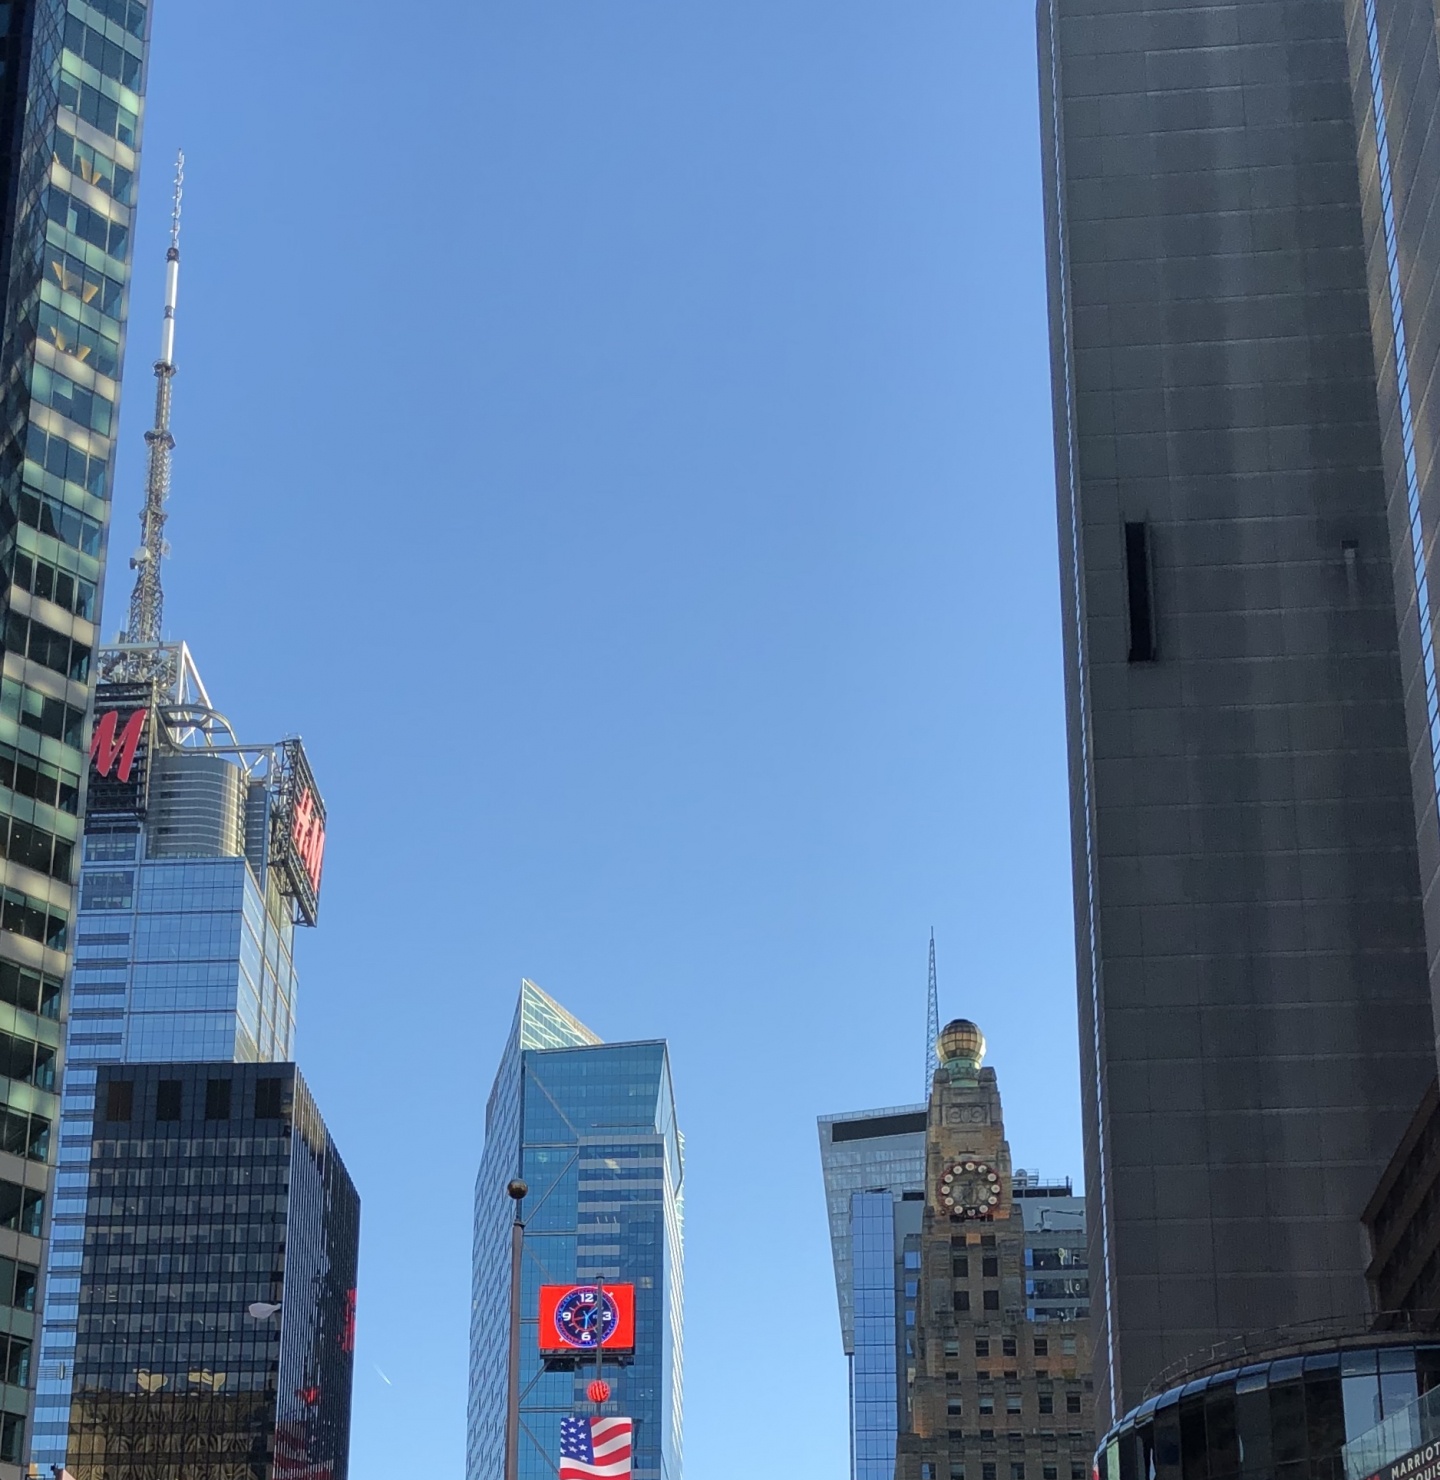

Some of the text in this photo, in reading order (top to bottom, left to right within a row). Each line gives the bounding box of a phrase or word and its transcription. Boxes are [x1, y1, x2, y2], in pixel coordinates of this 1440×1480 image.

[580, 1293, 594, 1303] 12
[562, 1311, 612, 1321] 9 3
[581, 1331, 591, 1341] 6
